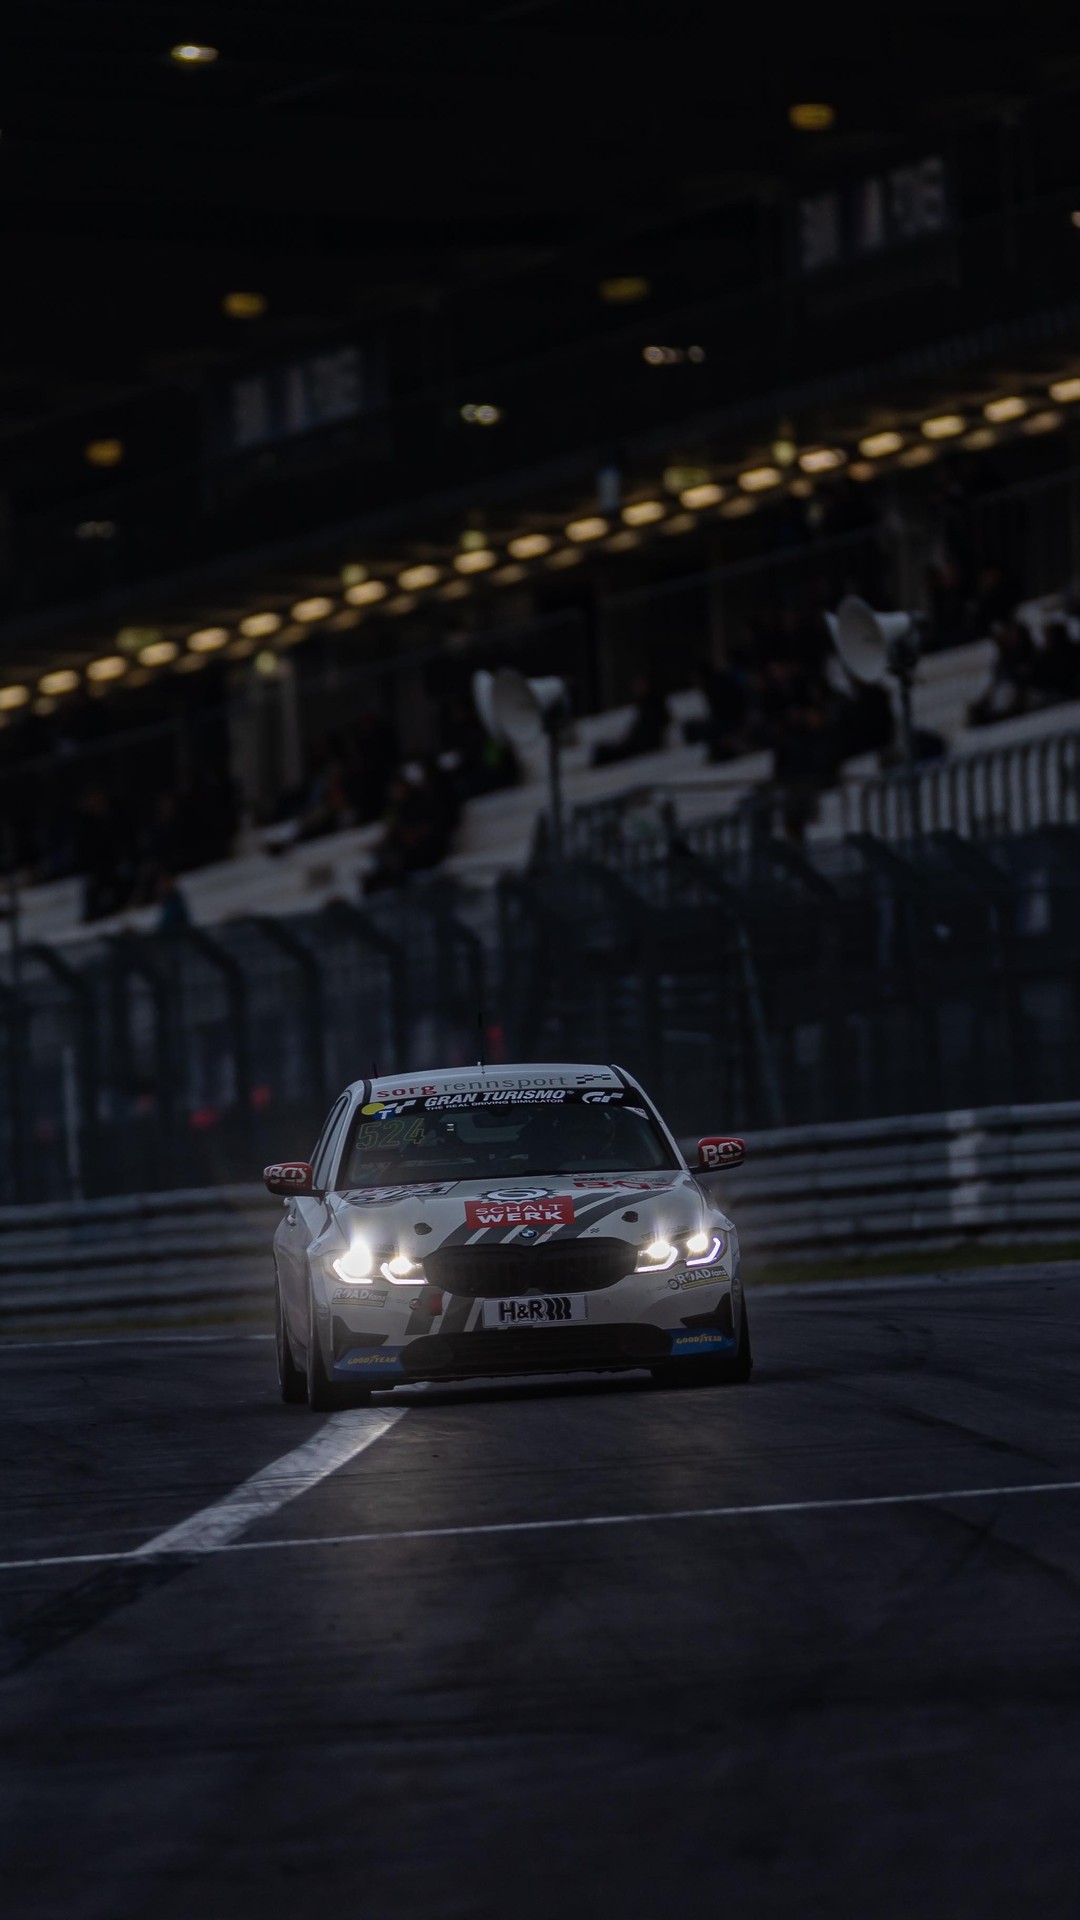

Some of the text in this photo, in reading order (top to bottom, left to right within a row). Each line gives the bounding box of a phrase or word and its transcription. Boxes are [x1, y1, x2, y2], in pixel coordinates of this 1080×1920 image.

[377, 1076, 568, 1098] sorg rennsport
[424, 1092, 478, 1107] GRAN
[355, 1117, 425, 1150] 524
[475, 1203, 563, 1215] SCHALT
[477, 1211, 563, 1224] WERK
[677, 1268, 711, 1284] ROAD
[333, 1288, 369, 1300] ROAD
[499, 1298, 544, 1323] H&R
[676, 1333, 722, 1345] GOODYEAR
[346, 1354, 397, 1365] GOODYEAR
